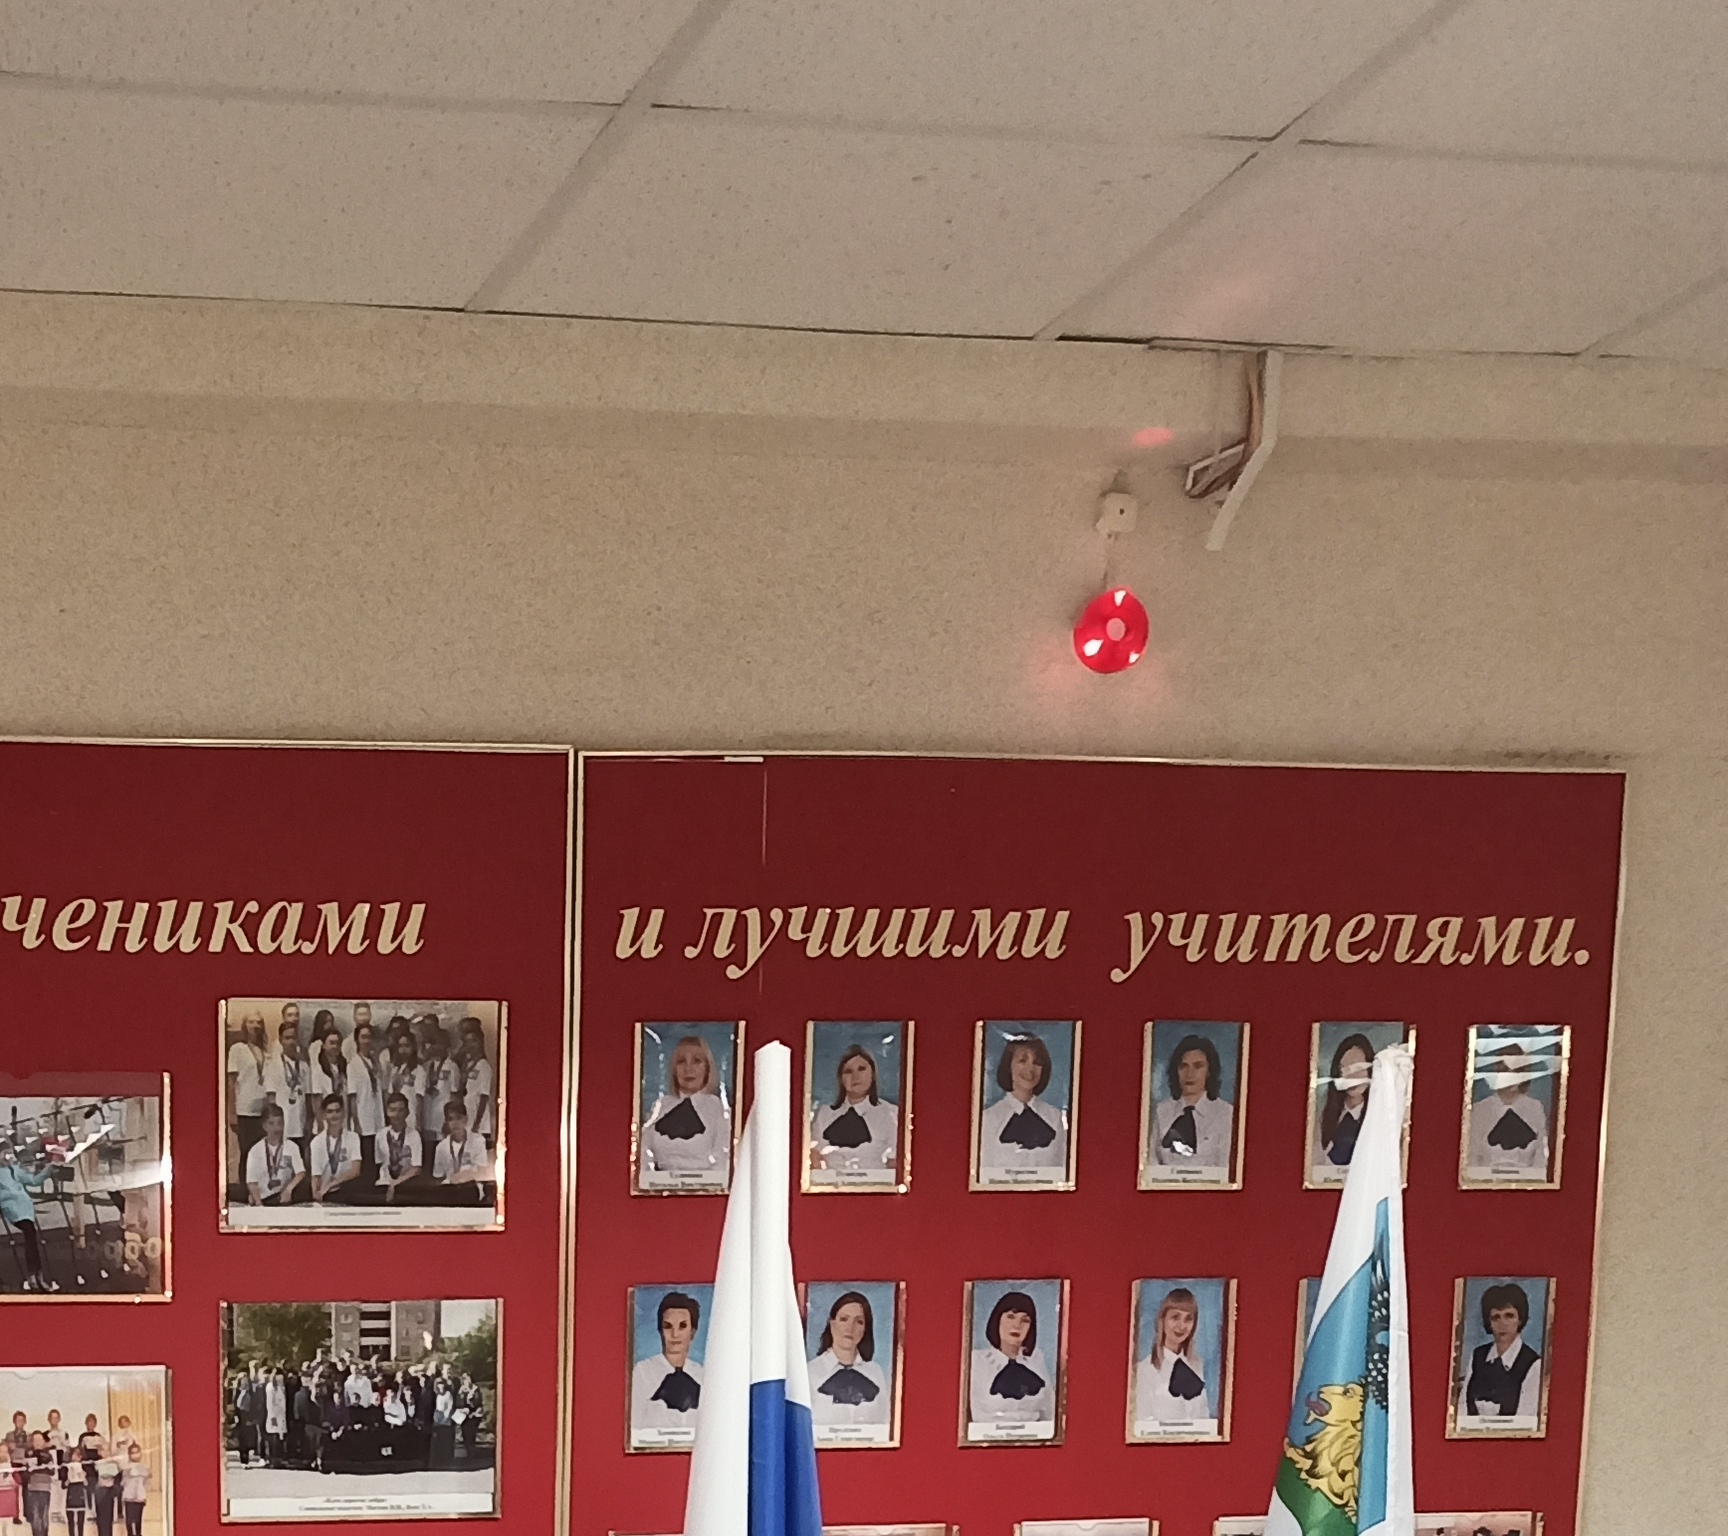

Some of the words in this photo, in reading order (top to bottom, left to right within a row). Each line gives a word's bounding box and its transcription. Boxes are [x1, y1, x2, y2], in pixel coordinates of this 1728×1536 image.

[615, 906, 665, 960] и
[684, 905, 1070, 980] лучшими
[1110, 911, 1590, 983] учителями.
